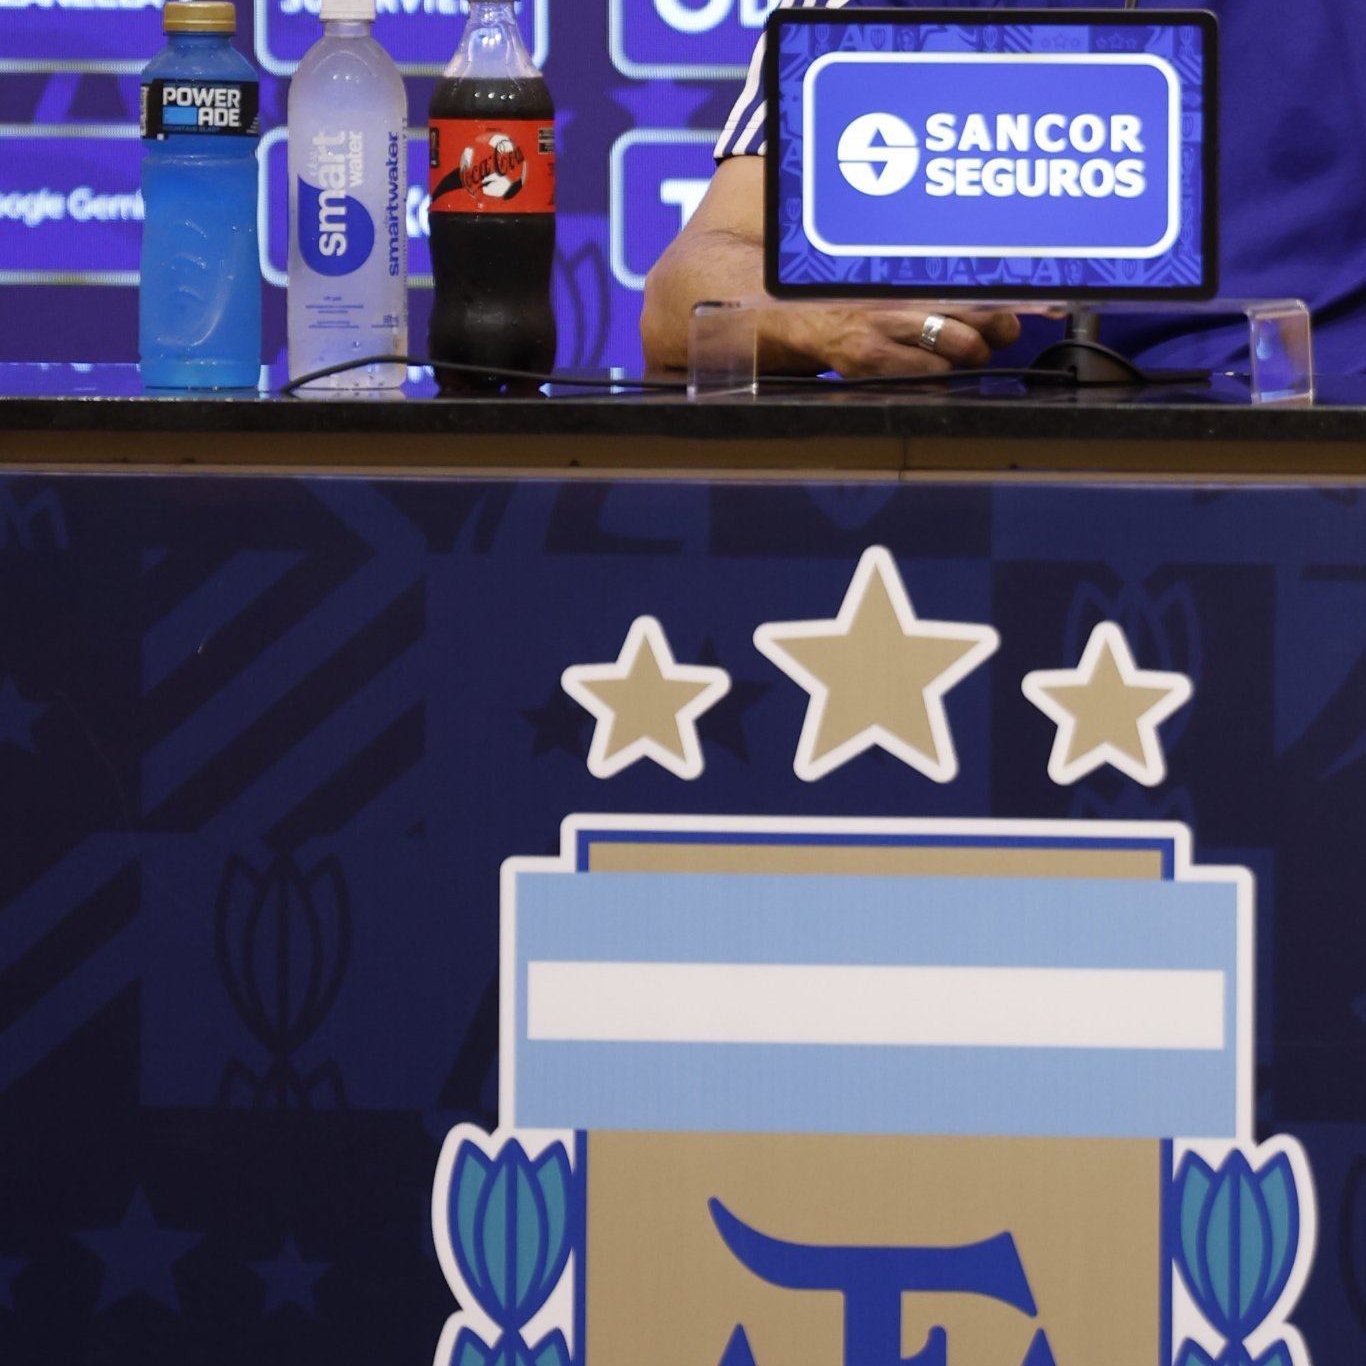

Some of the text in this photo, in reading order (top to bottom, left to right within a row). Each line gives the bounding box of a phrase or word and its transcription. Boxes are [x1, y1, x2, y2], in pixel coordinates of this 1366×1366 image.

[162, 87, 241, 108] POWER
[198, 107, 240, 127] ADE
[926, 113, 1143, 152] SANCOR
[349, 131, 363, 187] water
[926, 158, 1145, 197] SEGUROS
[313, 132, 346, 256] smart
[386, 131, 399, 276] smartwater
